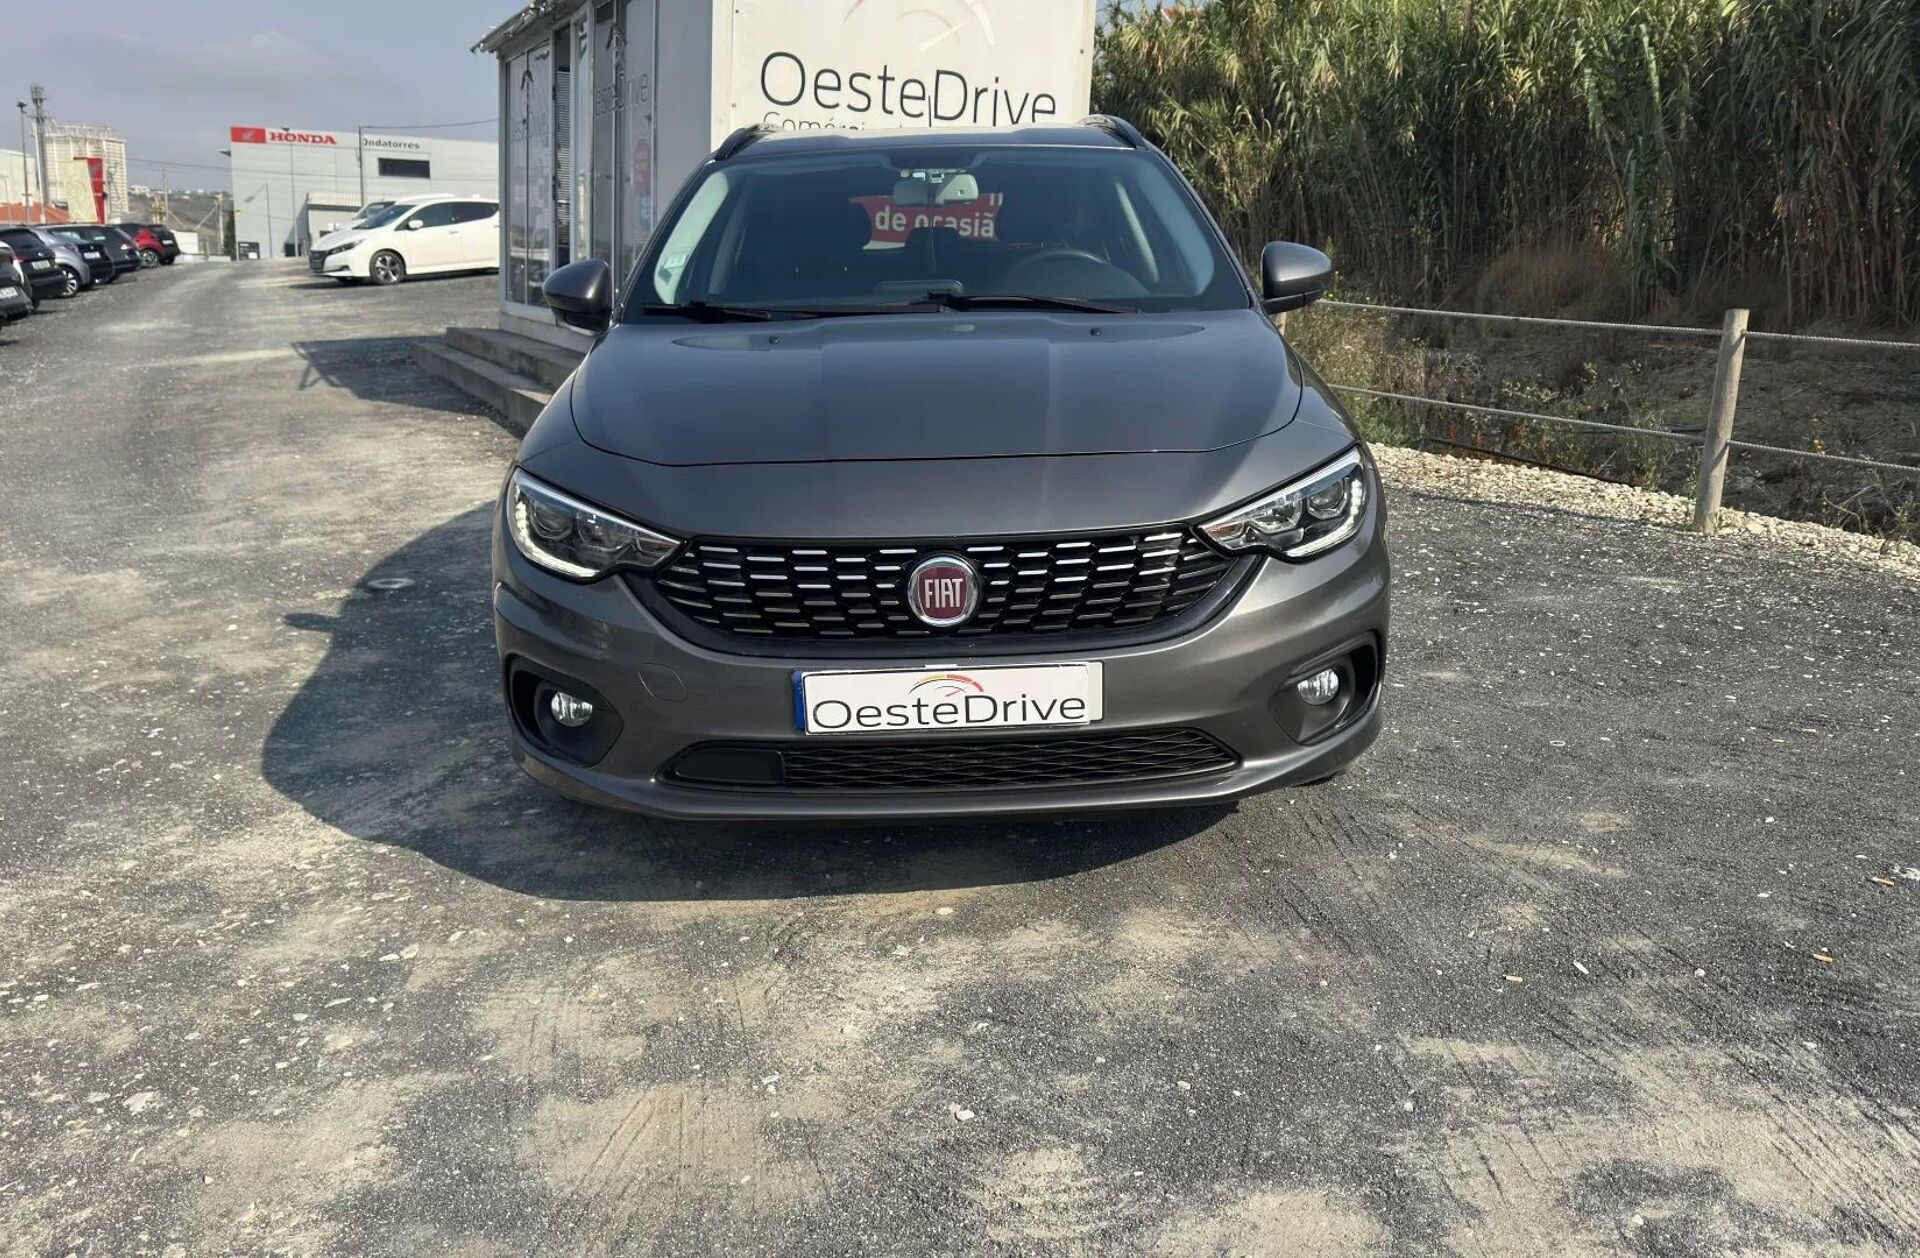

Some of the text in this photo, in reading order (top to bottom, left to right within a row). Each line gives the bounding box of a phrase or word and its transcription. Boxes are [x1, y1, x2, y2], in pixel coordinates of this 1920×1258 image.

[760, 51, 1057, 127] OesteDrive
[271, 132, 337, 145] HONDA
[875, 205, 907, 232] de
[923, 577, 963, 609] FIAT
[811, 693, 1087, 730] OesteDrive
